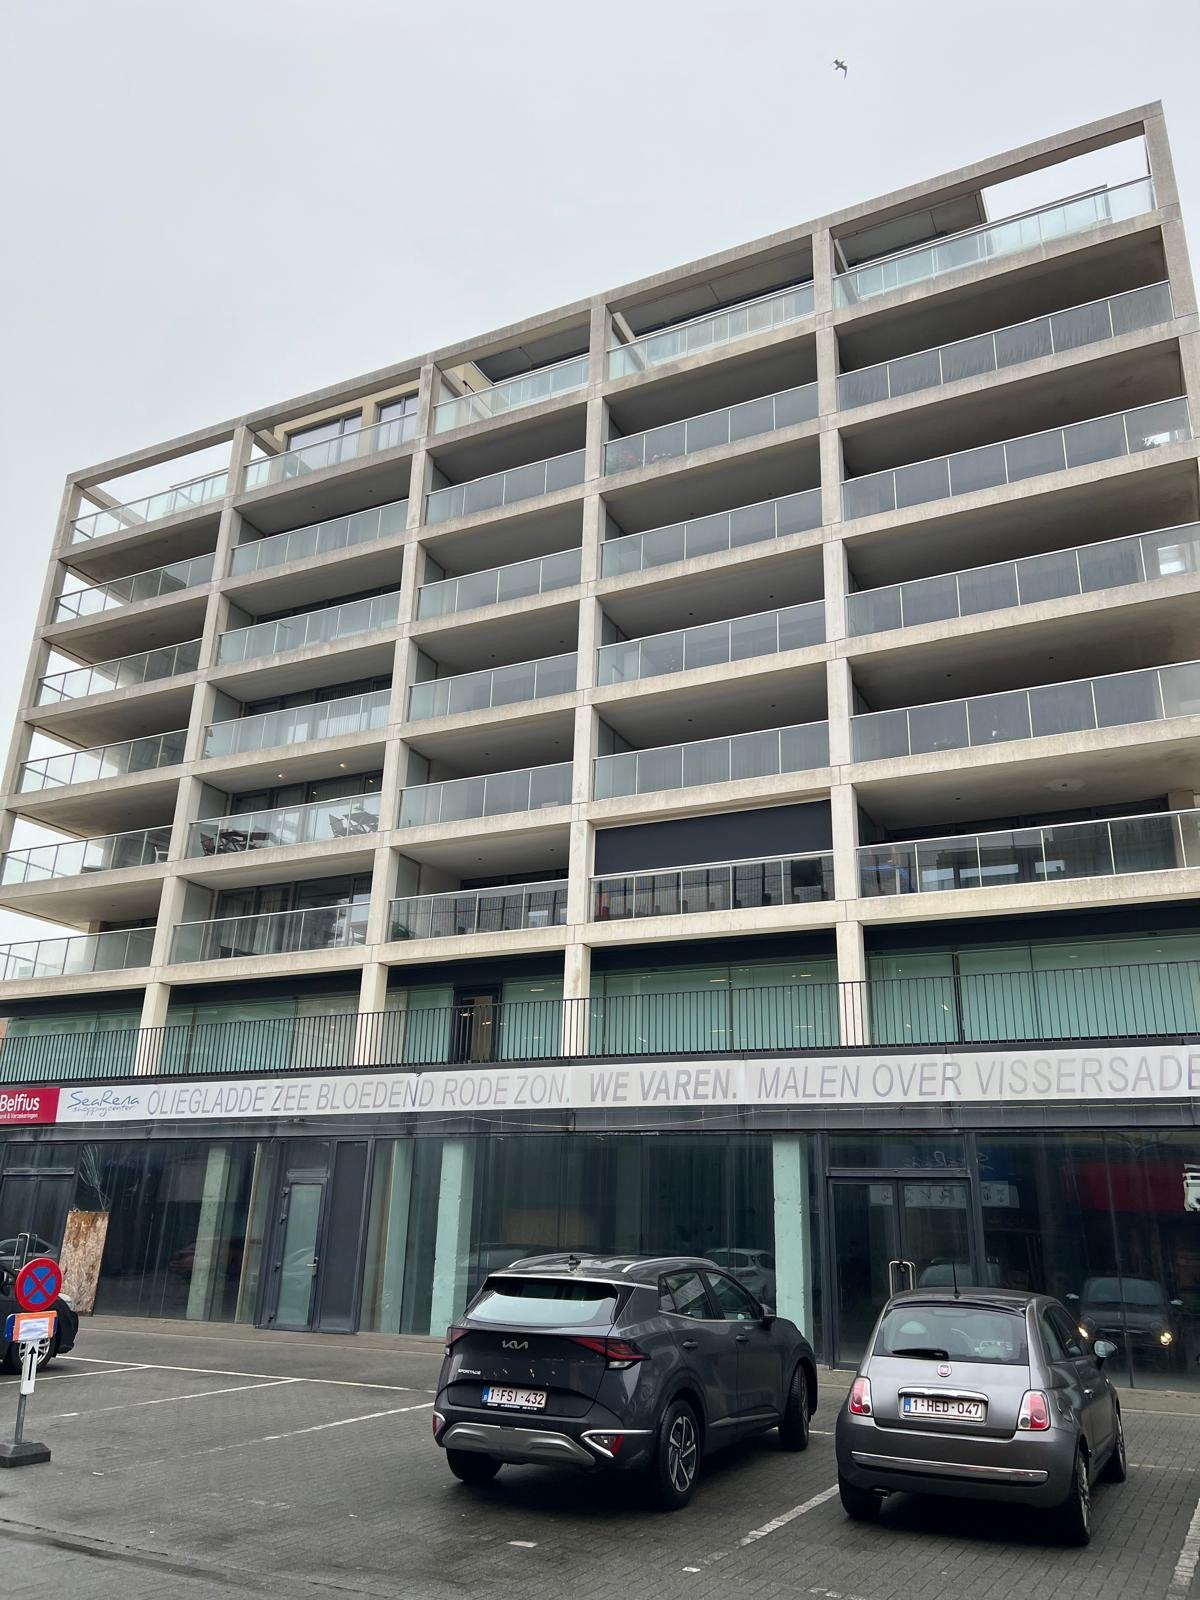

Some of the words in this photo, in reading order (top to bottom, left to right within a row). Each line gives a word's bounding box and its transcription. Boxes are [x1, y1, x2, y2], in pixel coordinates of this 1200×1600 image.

[147, 1085, 267, 1115] OLIEGLADDE
[271, 1084, 312, 1111] ZEE
[316, 1079, 434, 1110] BLOEDEND
[441, 1076, 510, 1106] RODE
[513, 1074, 570, 1105] ZON.
[590, 1071, 630, 1102] WE
[639, 1068, 737, 1101] VAREN.
[757, 1065, 860, 1099] MALEN
[872, 1062, 961, 1098] OVER
[0, 1094, 40, 1112] Belfius
[67, 1090, 139, 1109] SeaRena
